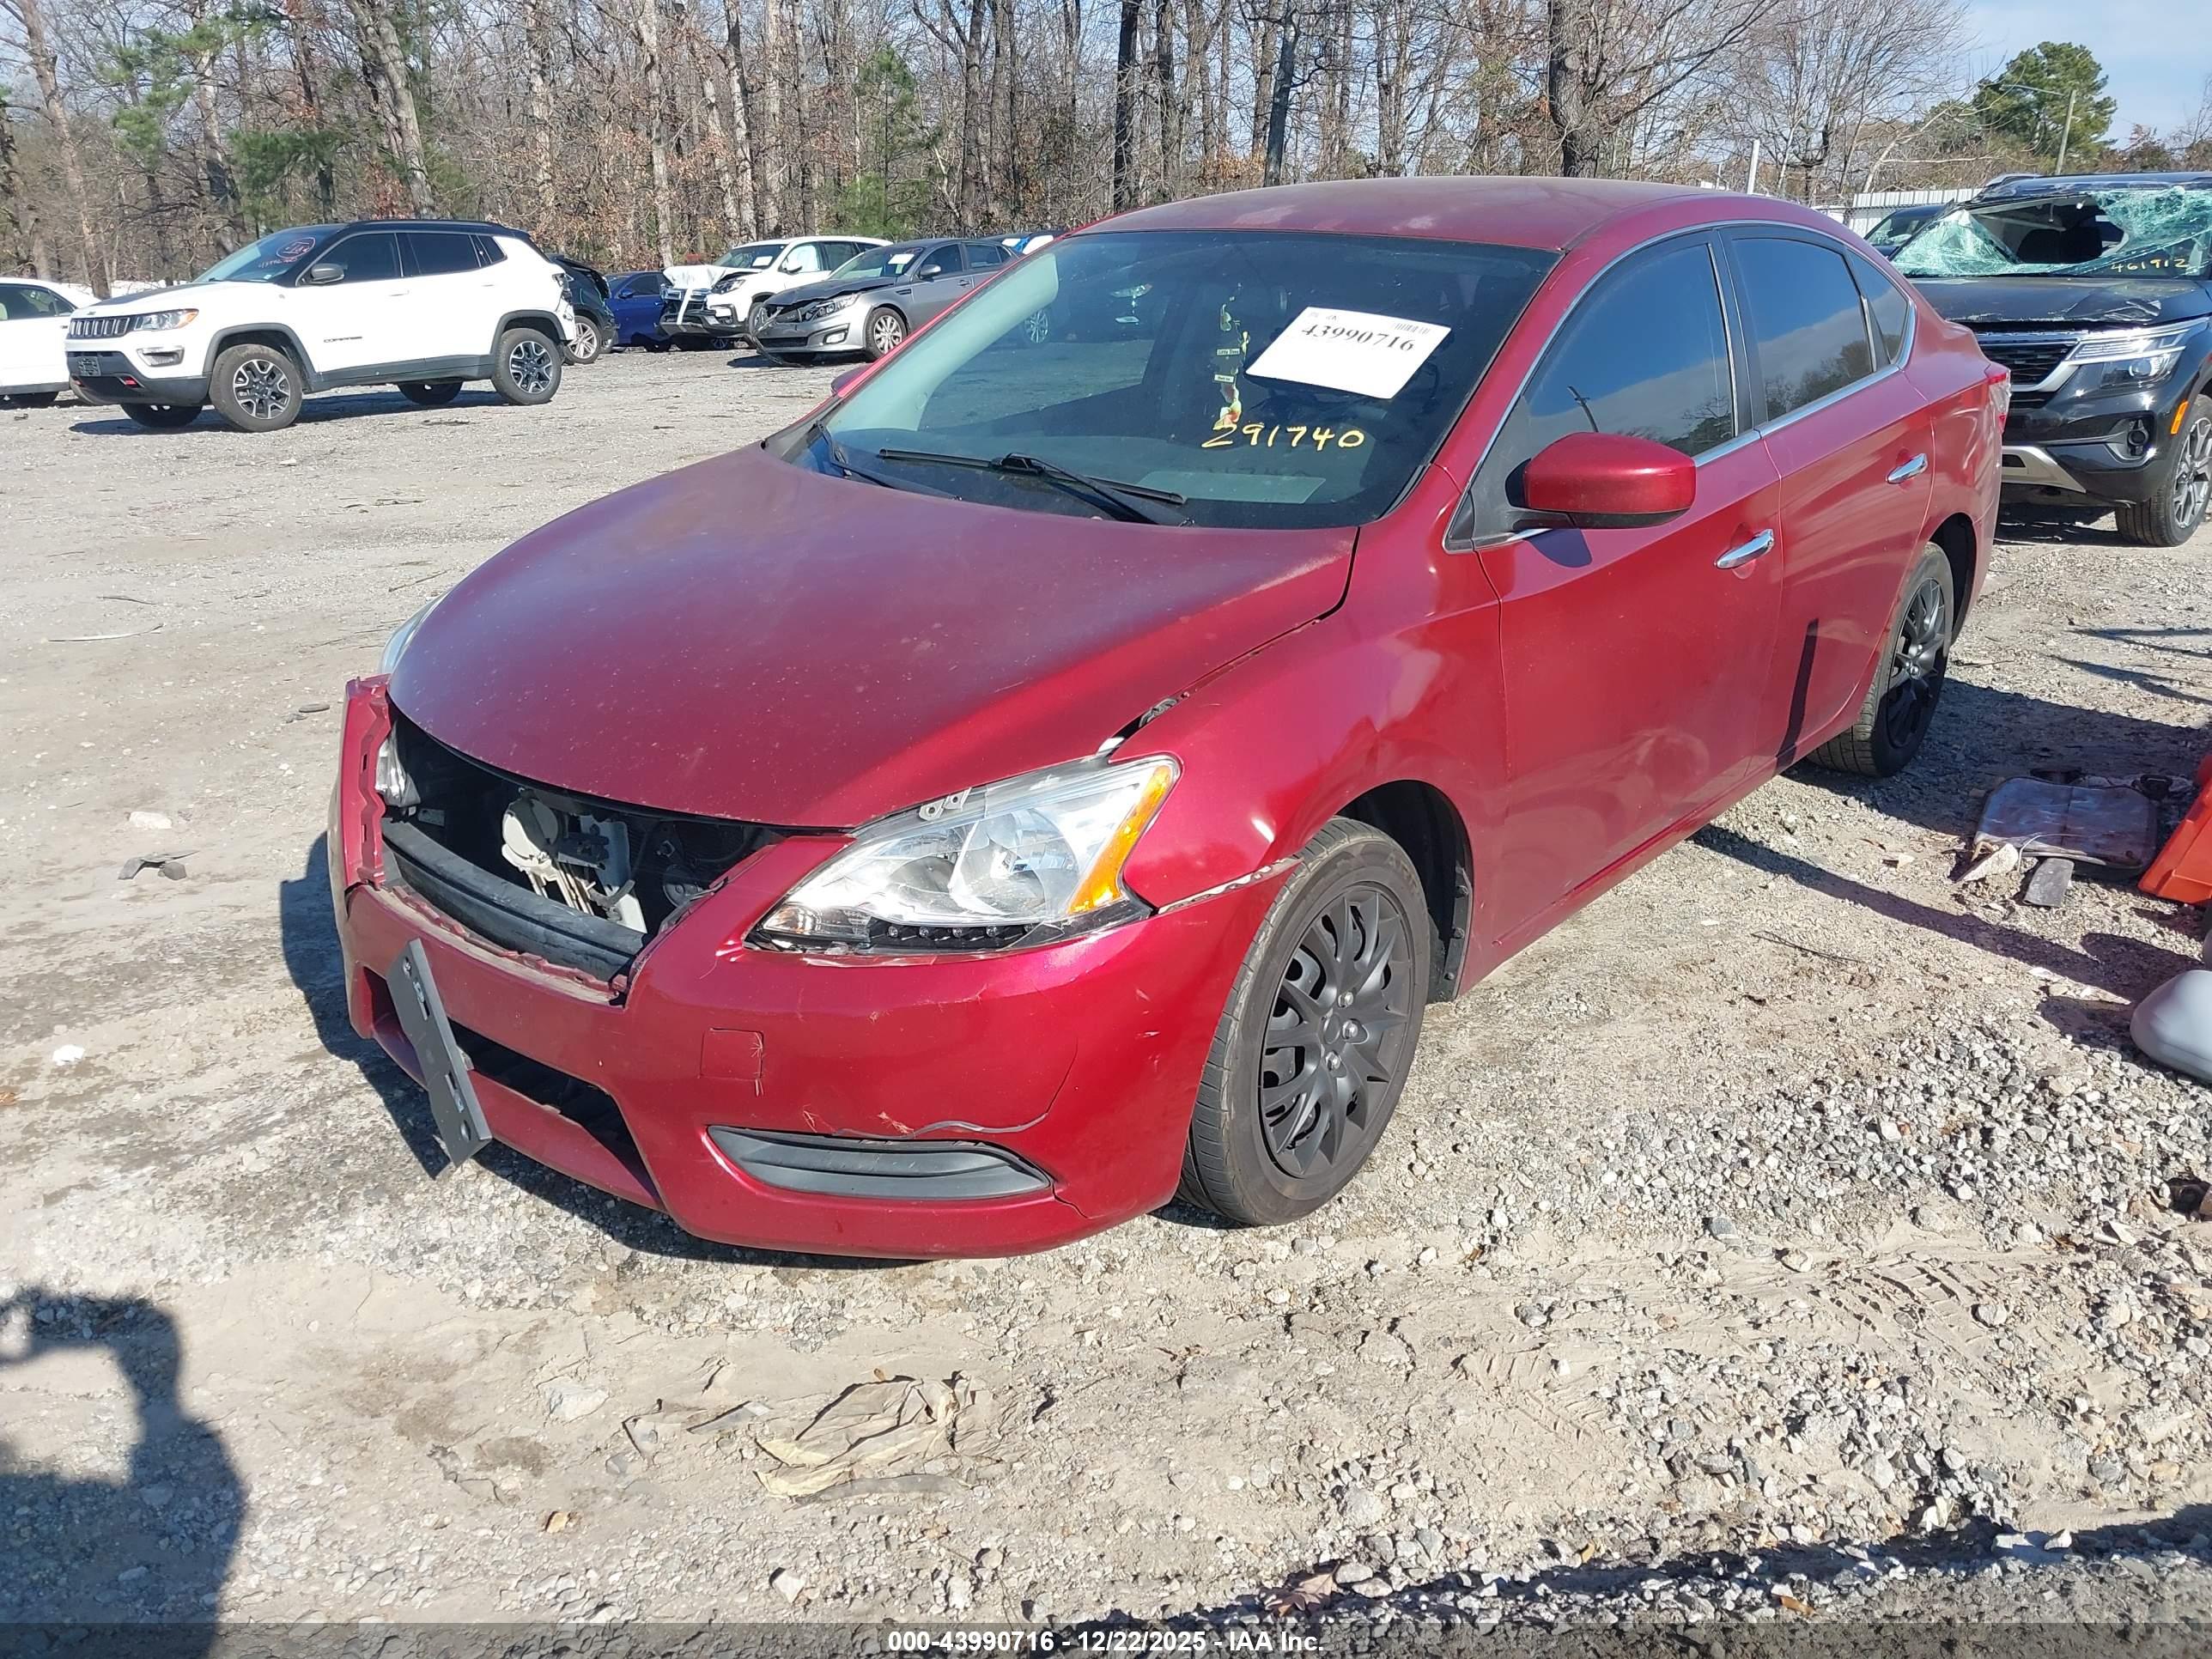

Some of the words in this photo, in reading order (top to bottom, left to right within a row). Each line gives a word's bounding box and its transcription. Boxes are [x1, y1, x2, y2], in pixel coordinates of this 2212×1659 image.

[2110, 258, 2190, 273] 461912
[1301, 323, 1415, 351] 43990716
[1201, 423, 1364, 451] 291740
